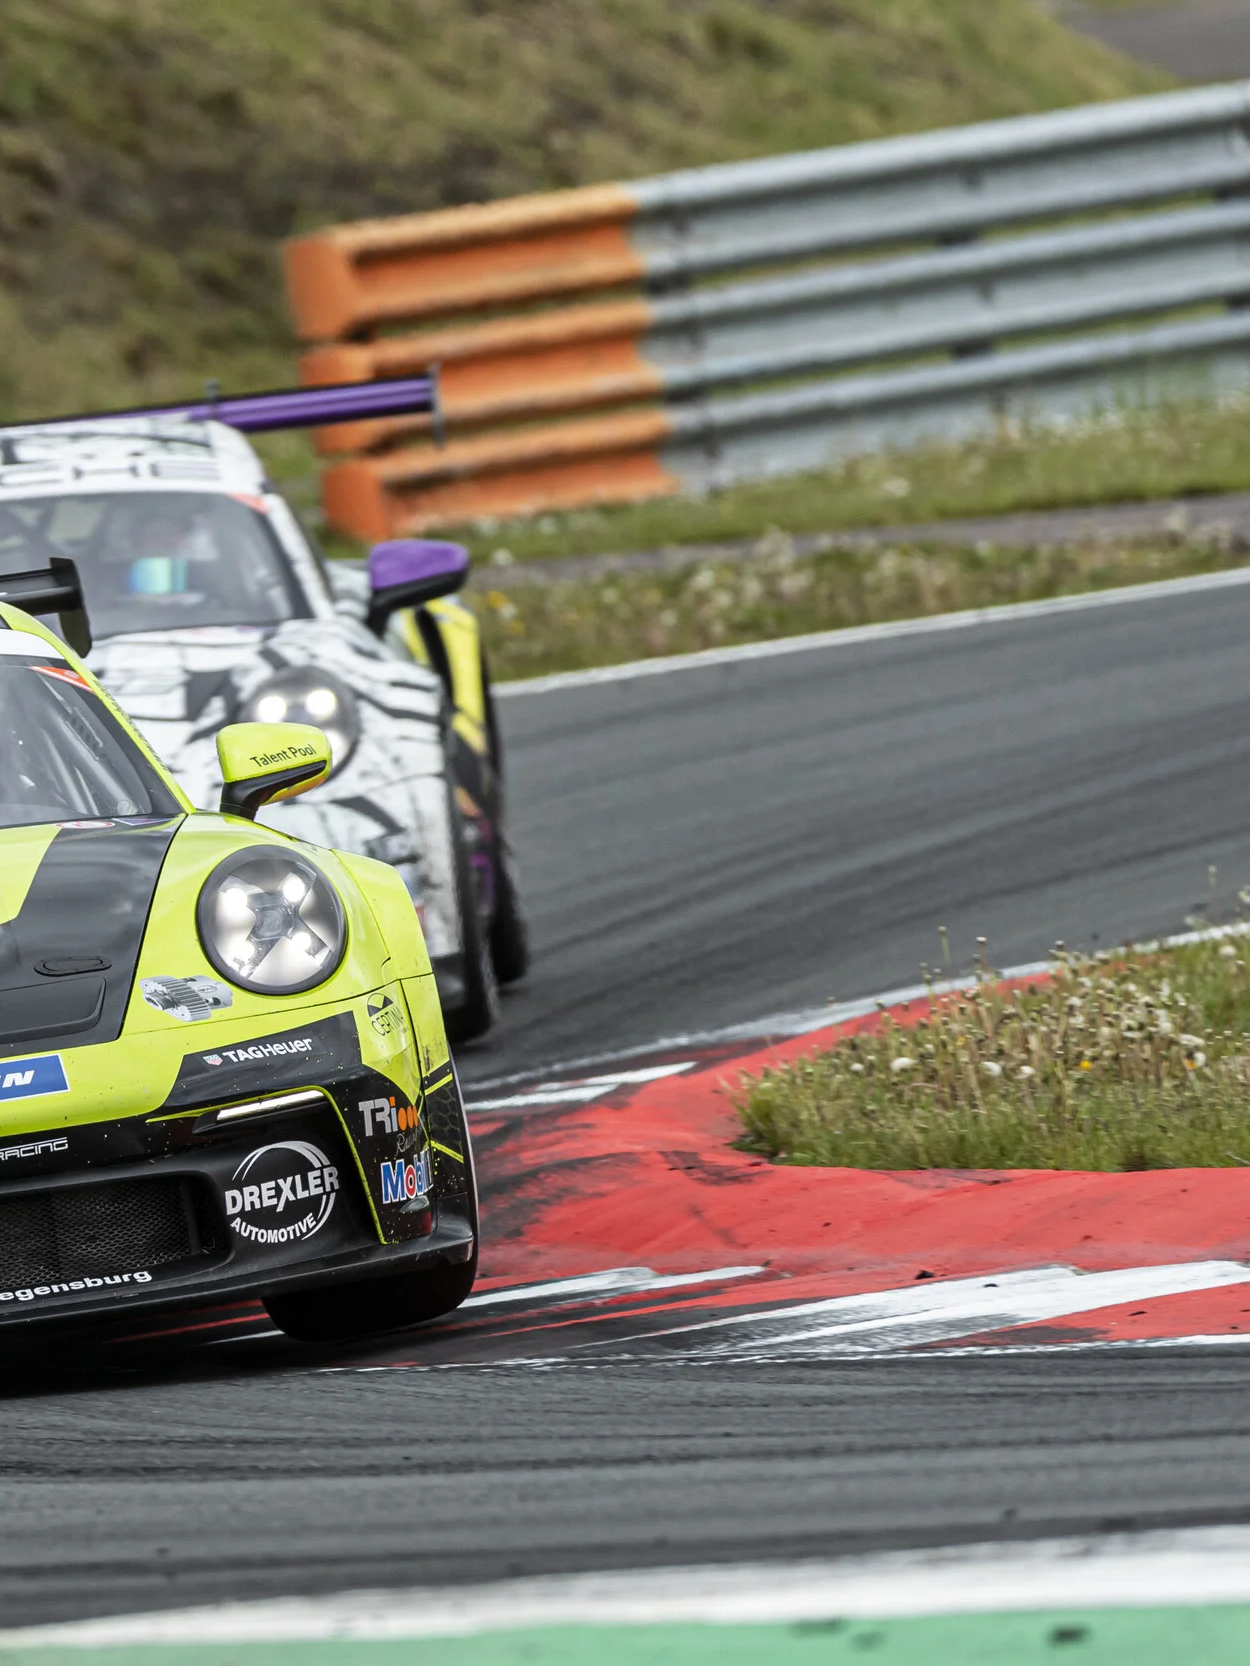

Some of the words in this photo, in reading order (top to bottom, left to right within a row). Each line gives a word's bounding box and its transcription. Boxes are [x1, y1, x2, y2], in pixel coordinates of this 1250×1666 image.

[249, 750, 291, 767] Talent
[287, 744, 317, 758] Pool
[225, 1166, 339, 1215] DREXLER
[230, 1212, 316, 1243] AUTOMOTIVE
